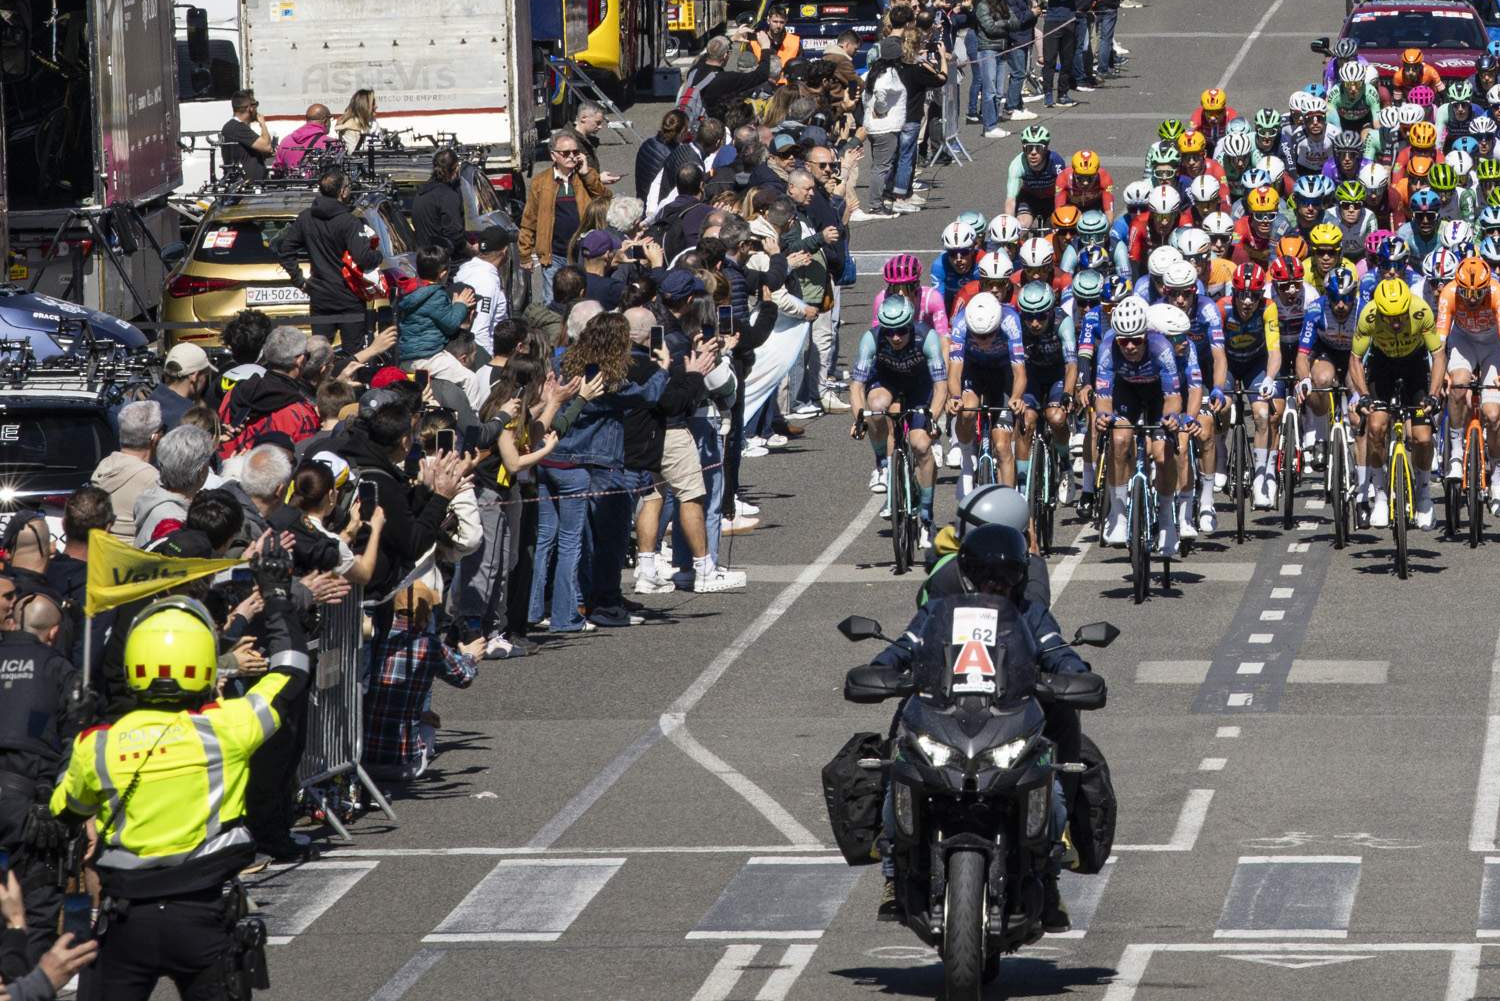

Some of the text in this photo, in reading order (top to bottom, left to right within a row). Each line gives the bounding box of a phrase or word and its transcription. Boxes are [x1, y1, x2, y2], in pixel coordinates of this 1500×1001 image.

[1435, 58, 1476, 68] Volta
[1302, 321, 1314, 344] BOSS
[972, 627, 993, 643] 62
[0, 659, 34, 672] ICIA
